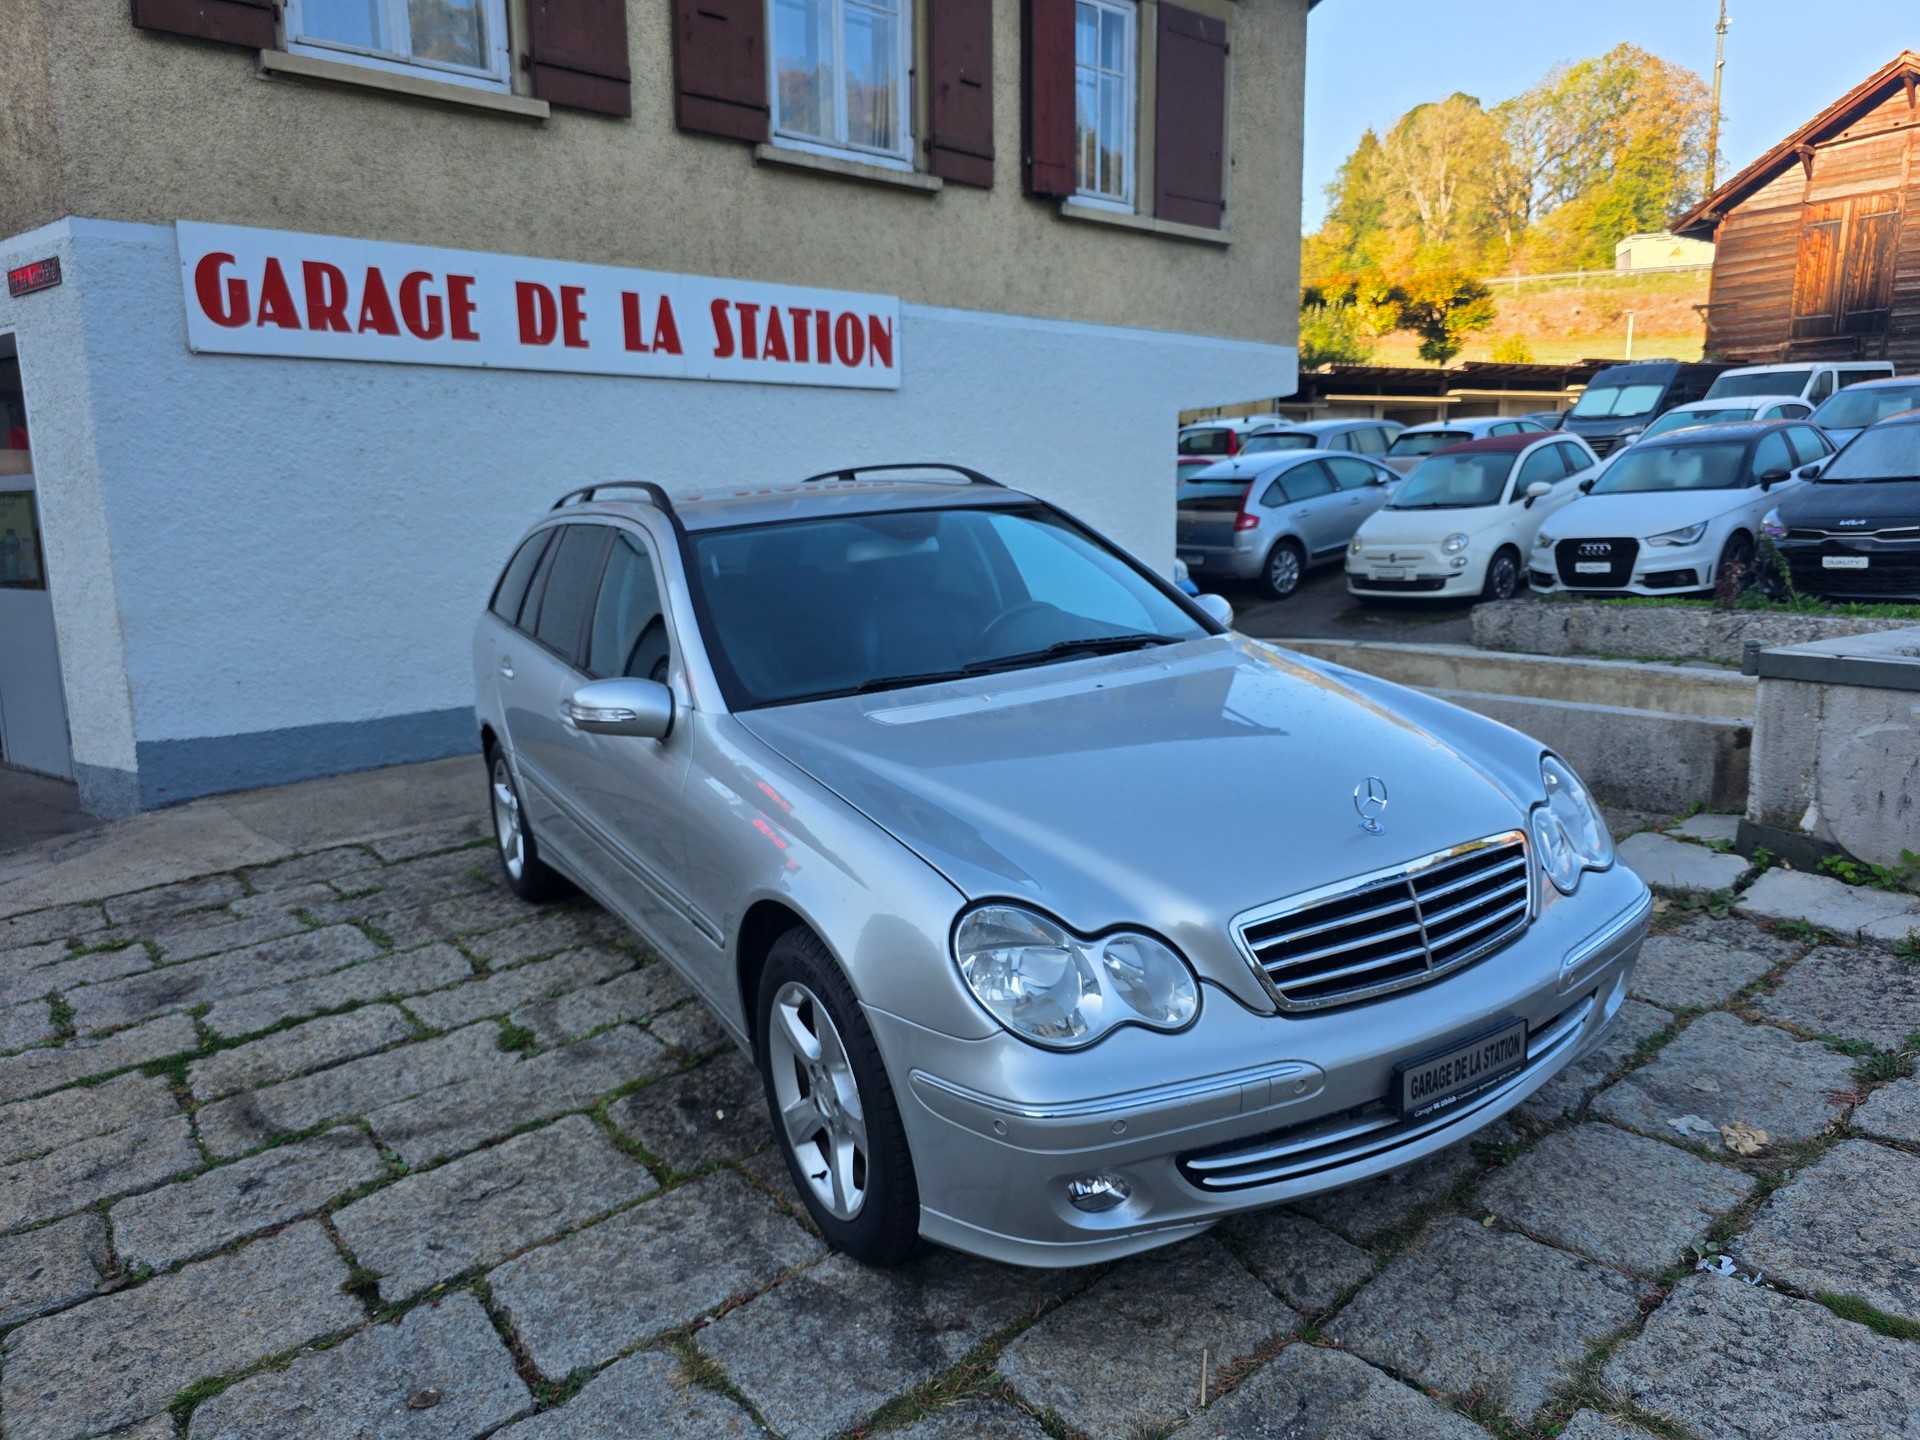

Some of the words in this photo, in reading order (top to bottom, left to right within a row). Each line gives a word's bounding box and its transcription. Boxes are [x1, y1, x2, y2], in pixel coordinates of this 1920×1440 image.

[194, 251, 481, 342] GARAGE
[514, 280, 590, 349] DE
[621, 291, 684, 355] LA
[710, 298, 893, 369] STATION
[1411, 1062, 1452, 1100] GARAGE
[1454, 1056, 1467, 1083] DE
[1469, 1050, 1482, 1076] LA
[1483, 1031, 1520, 1070] STATION
